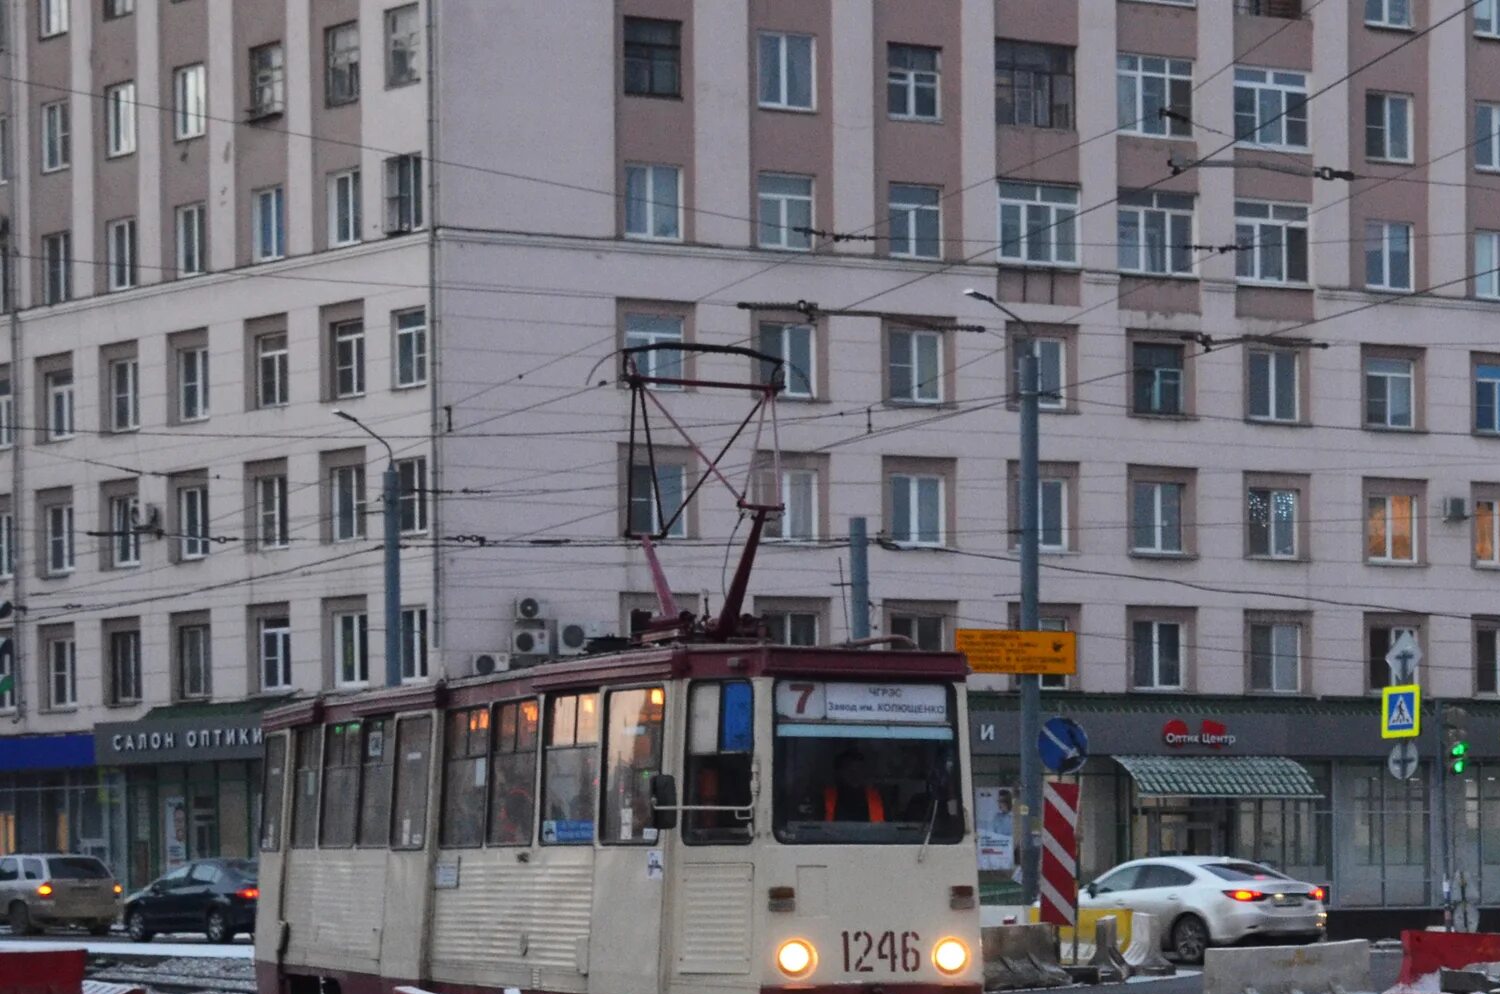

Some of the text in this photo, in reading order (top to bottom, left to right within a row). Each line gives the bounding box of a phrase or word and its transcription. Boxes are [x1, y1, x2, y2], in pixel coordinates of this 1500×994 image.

[789, 684, 815, 715] 7
[112, 727, 263, 751] САЛОН ОПТИКИ
[1202, 733, 1236, 745] Центр
[842, 931, 920, 972] 1246
